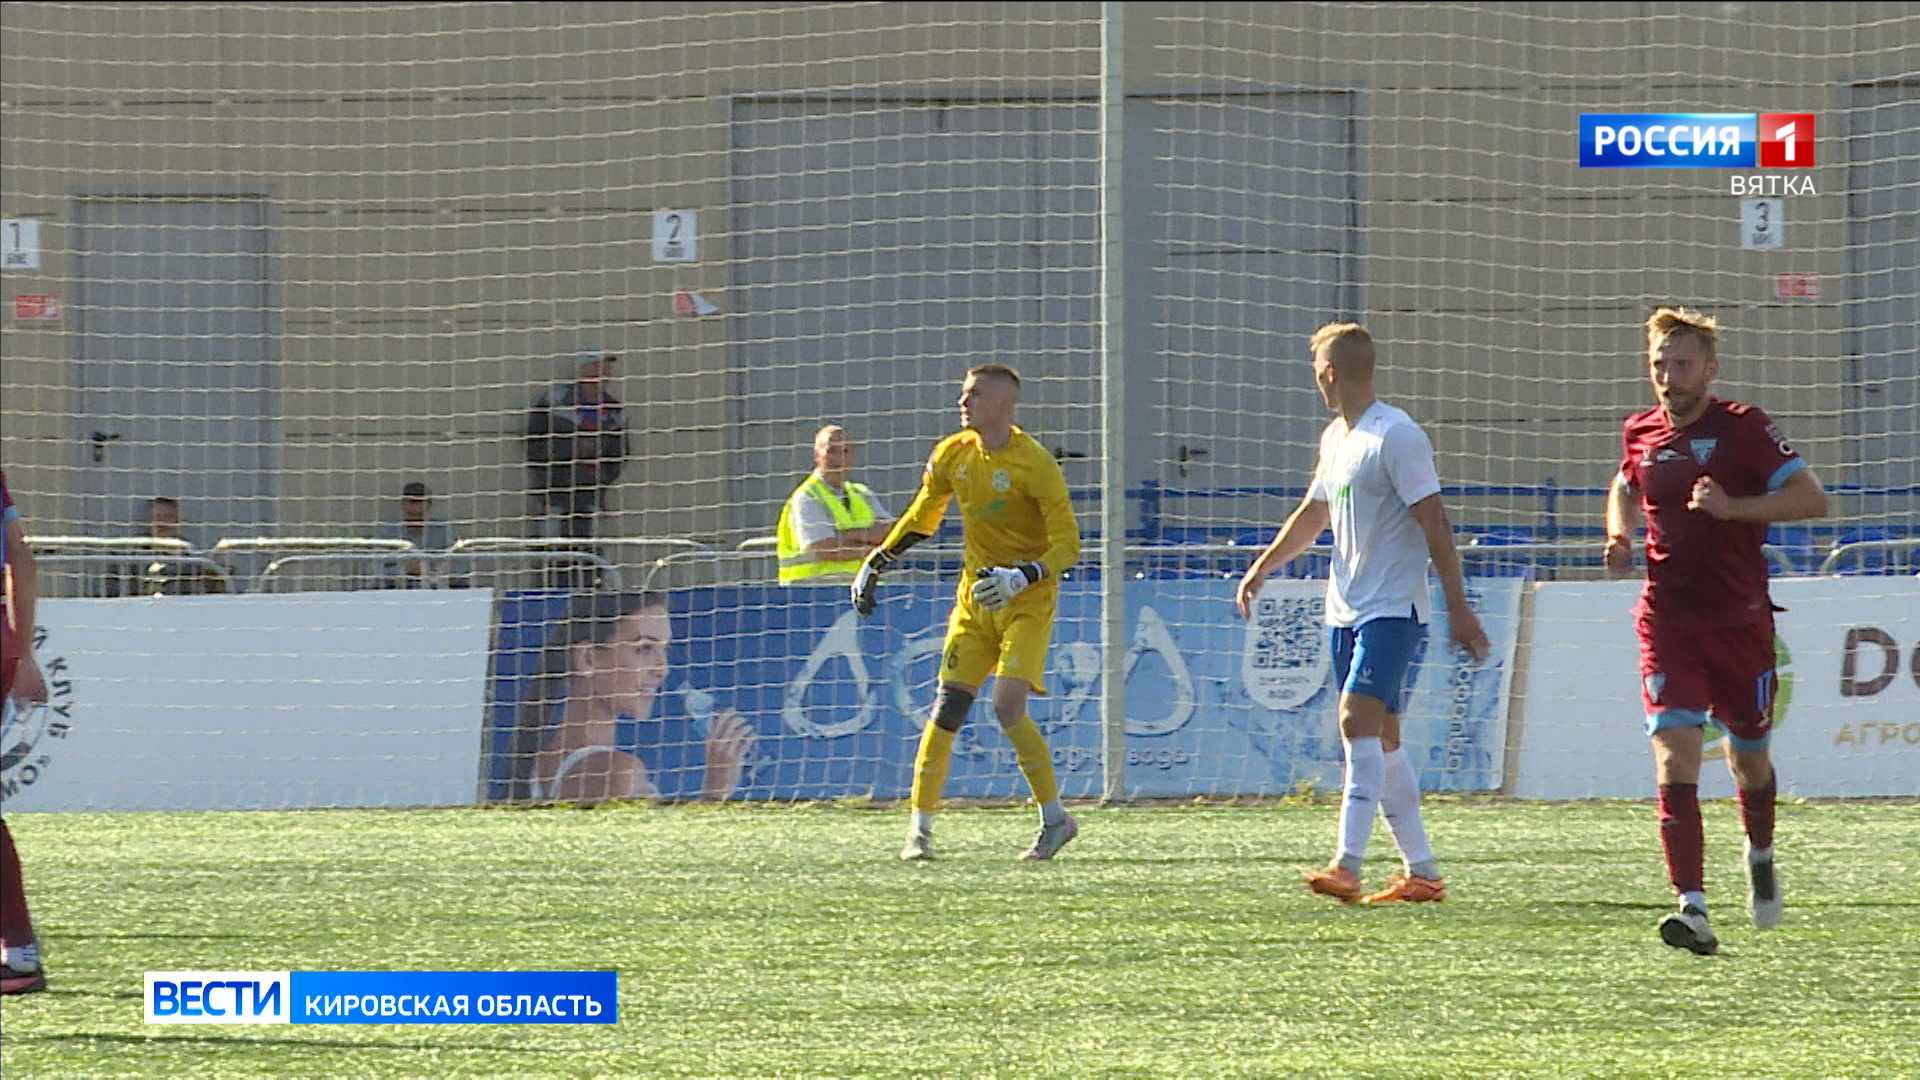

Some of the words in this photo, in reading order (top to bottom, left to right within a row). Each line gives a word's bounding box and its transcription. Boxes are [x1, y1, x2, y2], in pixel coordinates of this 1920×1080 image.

[666, 214, 682, 246] 2
[1755, 201, 1769, 232] 3
[9, 223, 20, 252] 1
